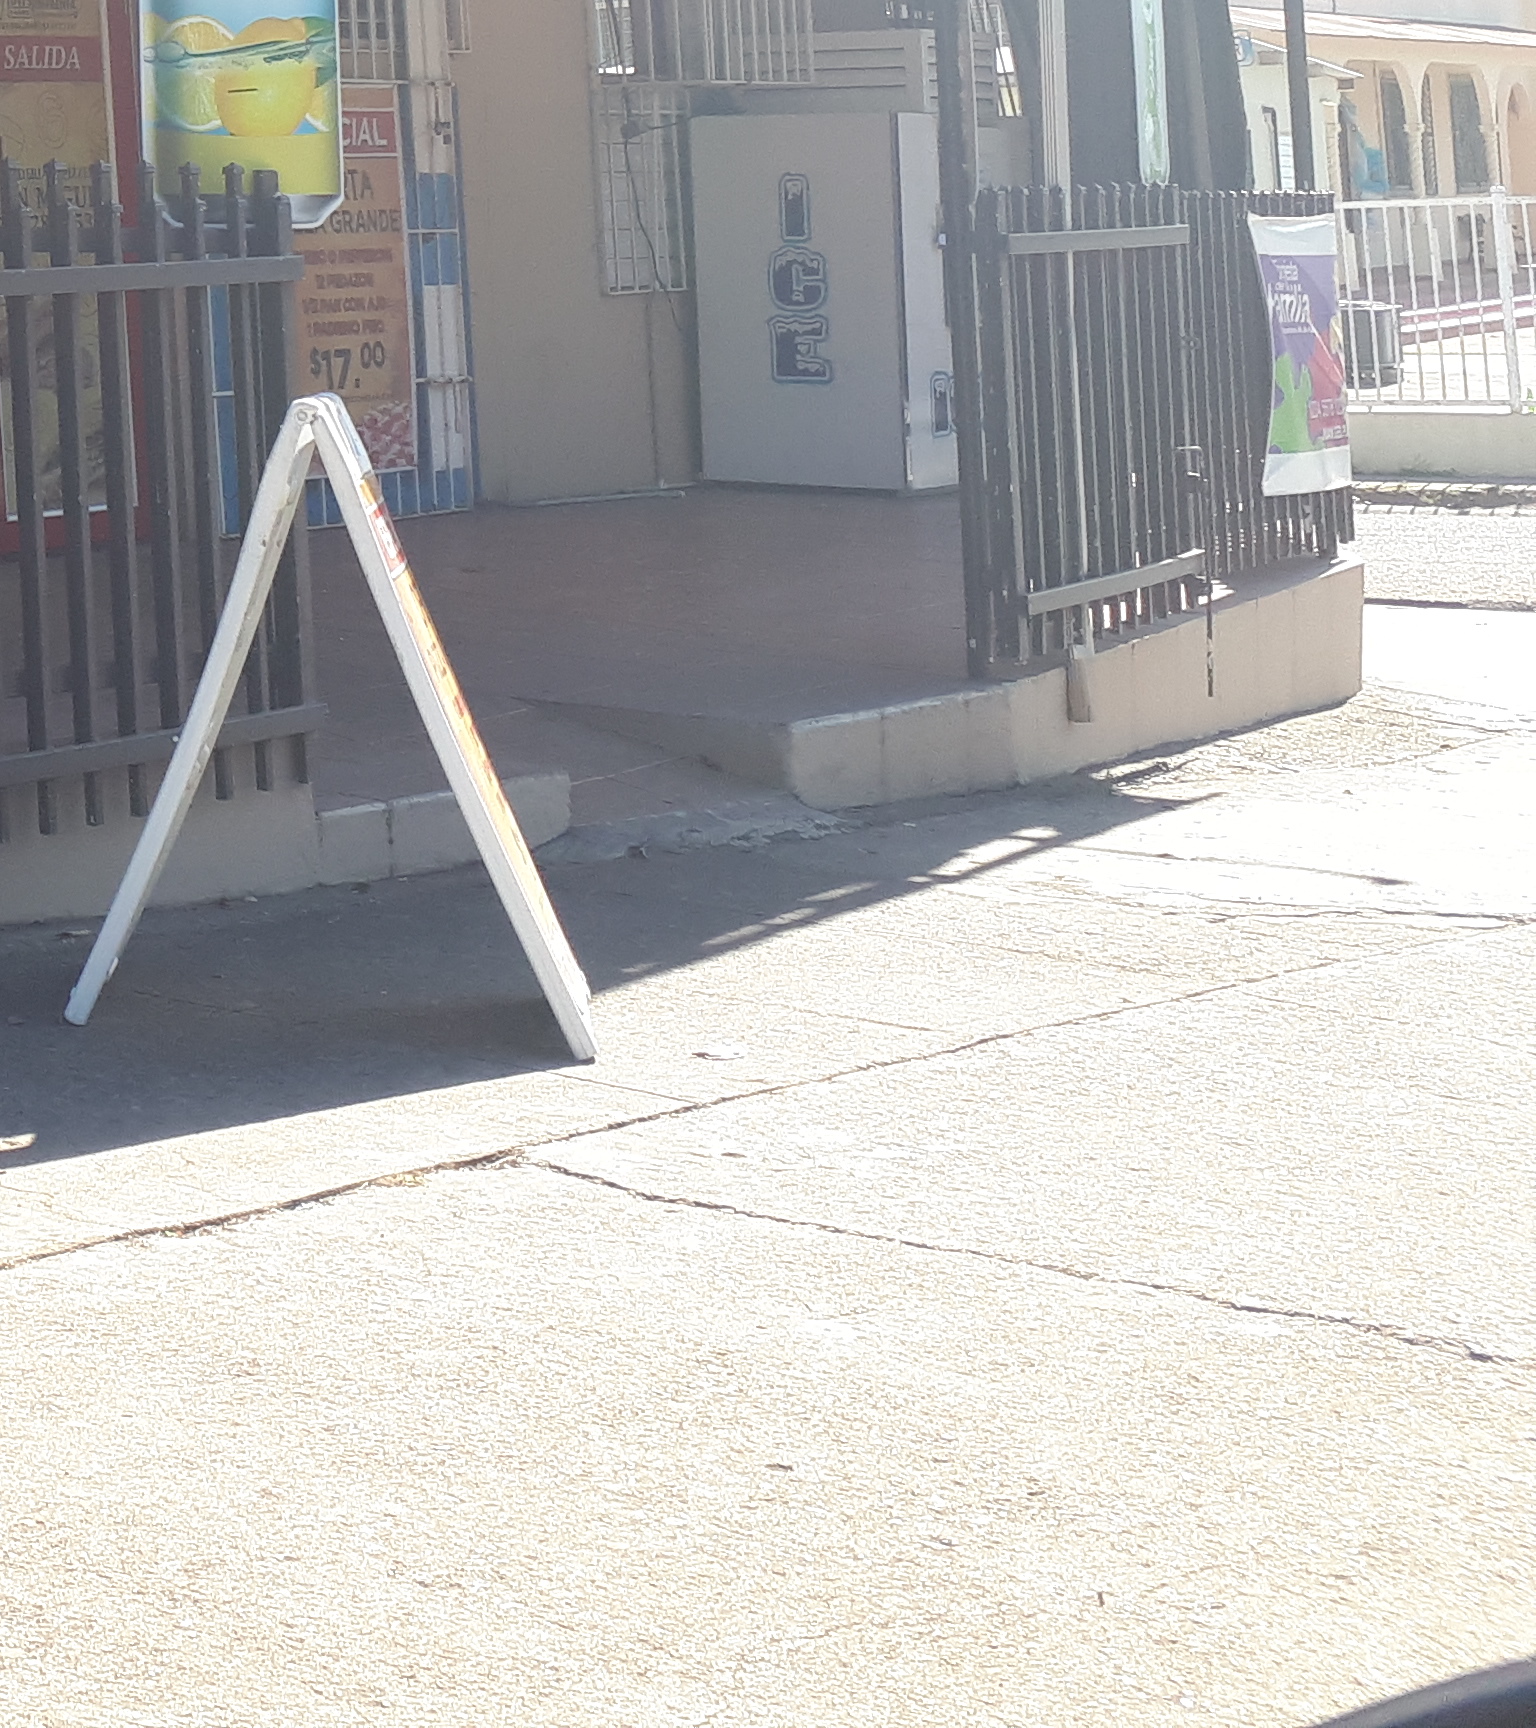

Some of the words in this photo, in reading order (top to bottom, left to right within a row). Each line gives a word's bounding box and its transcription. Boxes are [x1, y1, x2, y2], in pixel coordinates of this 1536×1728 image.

[3, 44, 81, 70] SALIDA
[329, 208, 401, 234] GRANDE
[766, 171, 834, 384] ICE
